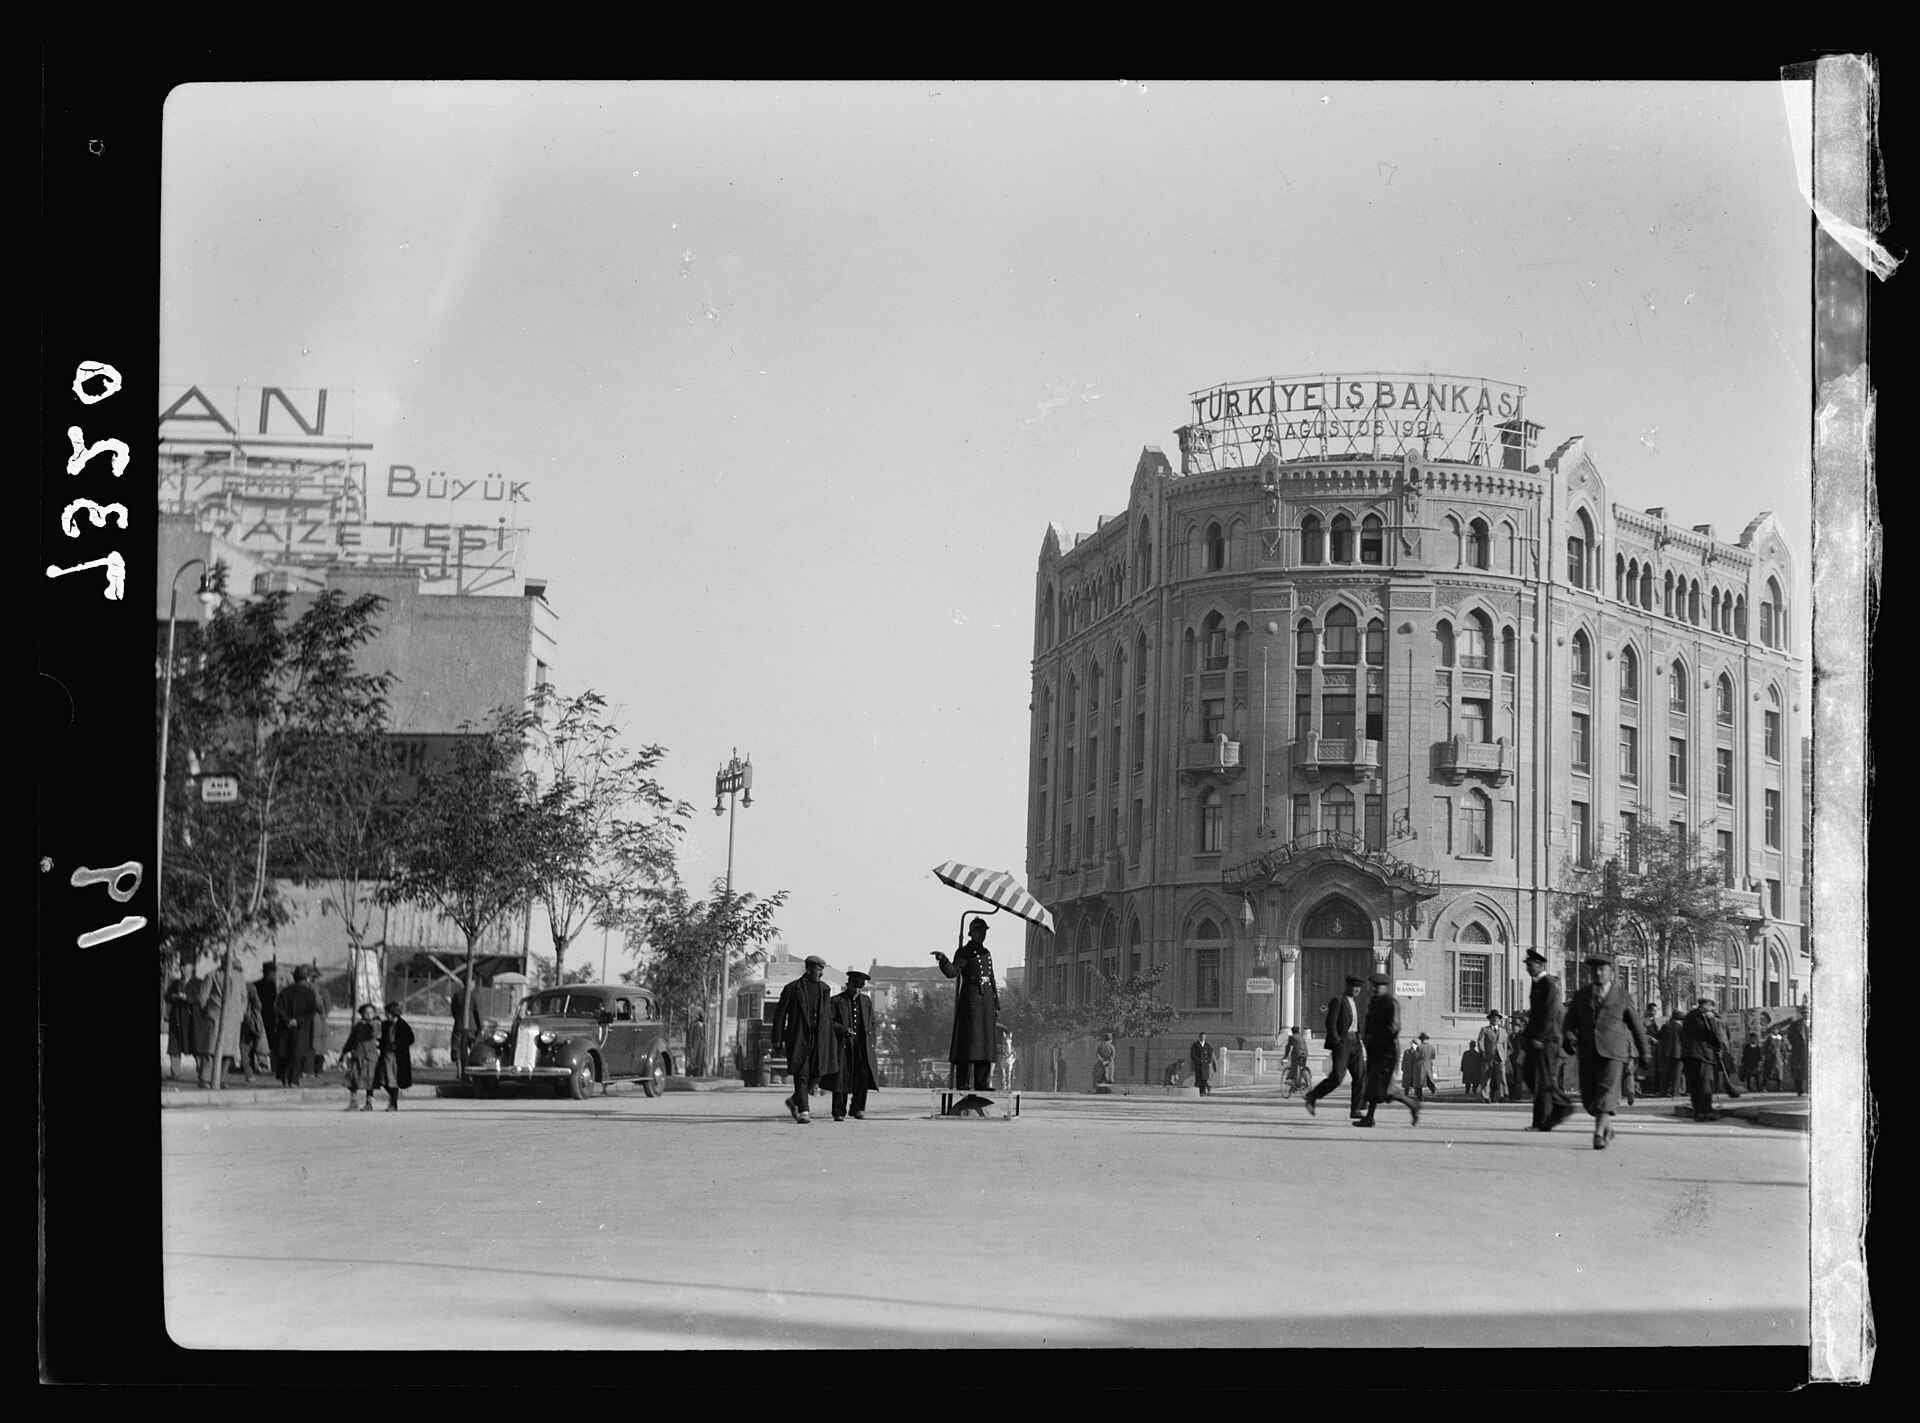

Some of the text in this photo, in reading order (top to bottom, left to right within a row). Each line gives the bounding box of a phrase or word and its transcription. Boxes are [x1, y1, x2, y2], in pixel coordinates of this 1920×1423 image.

[1377, 381, 1521, 419] BANKASI
[1251, 424, 1274, 441] 26
[387, 464, 530, 502] BÜYÜK
